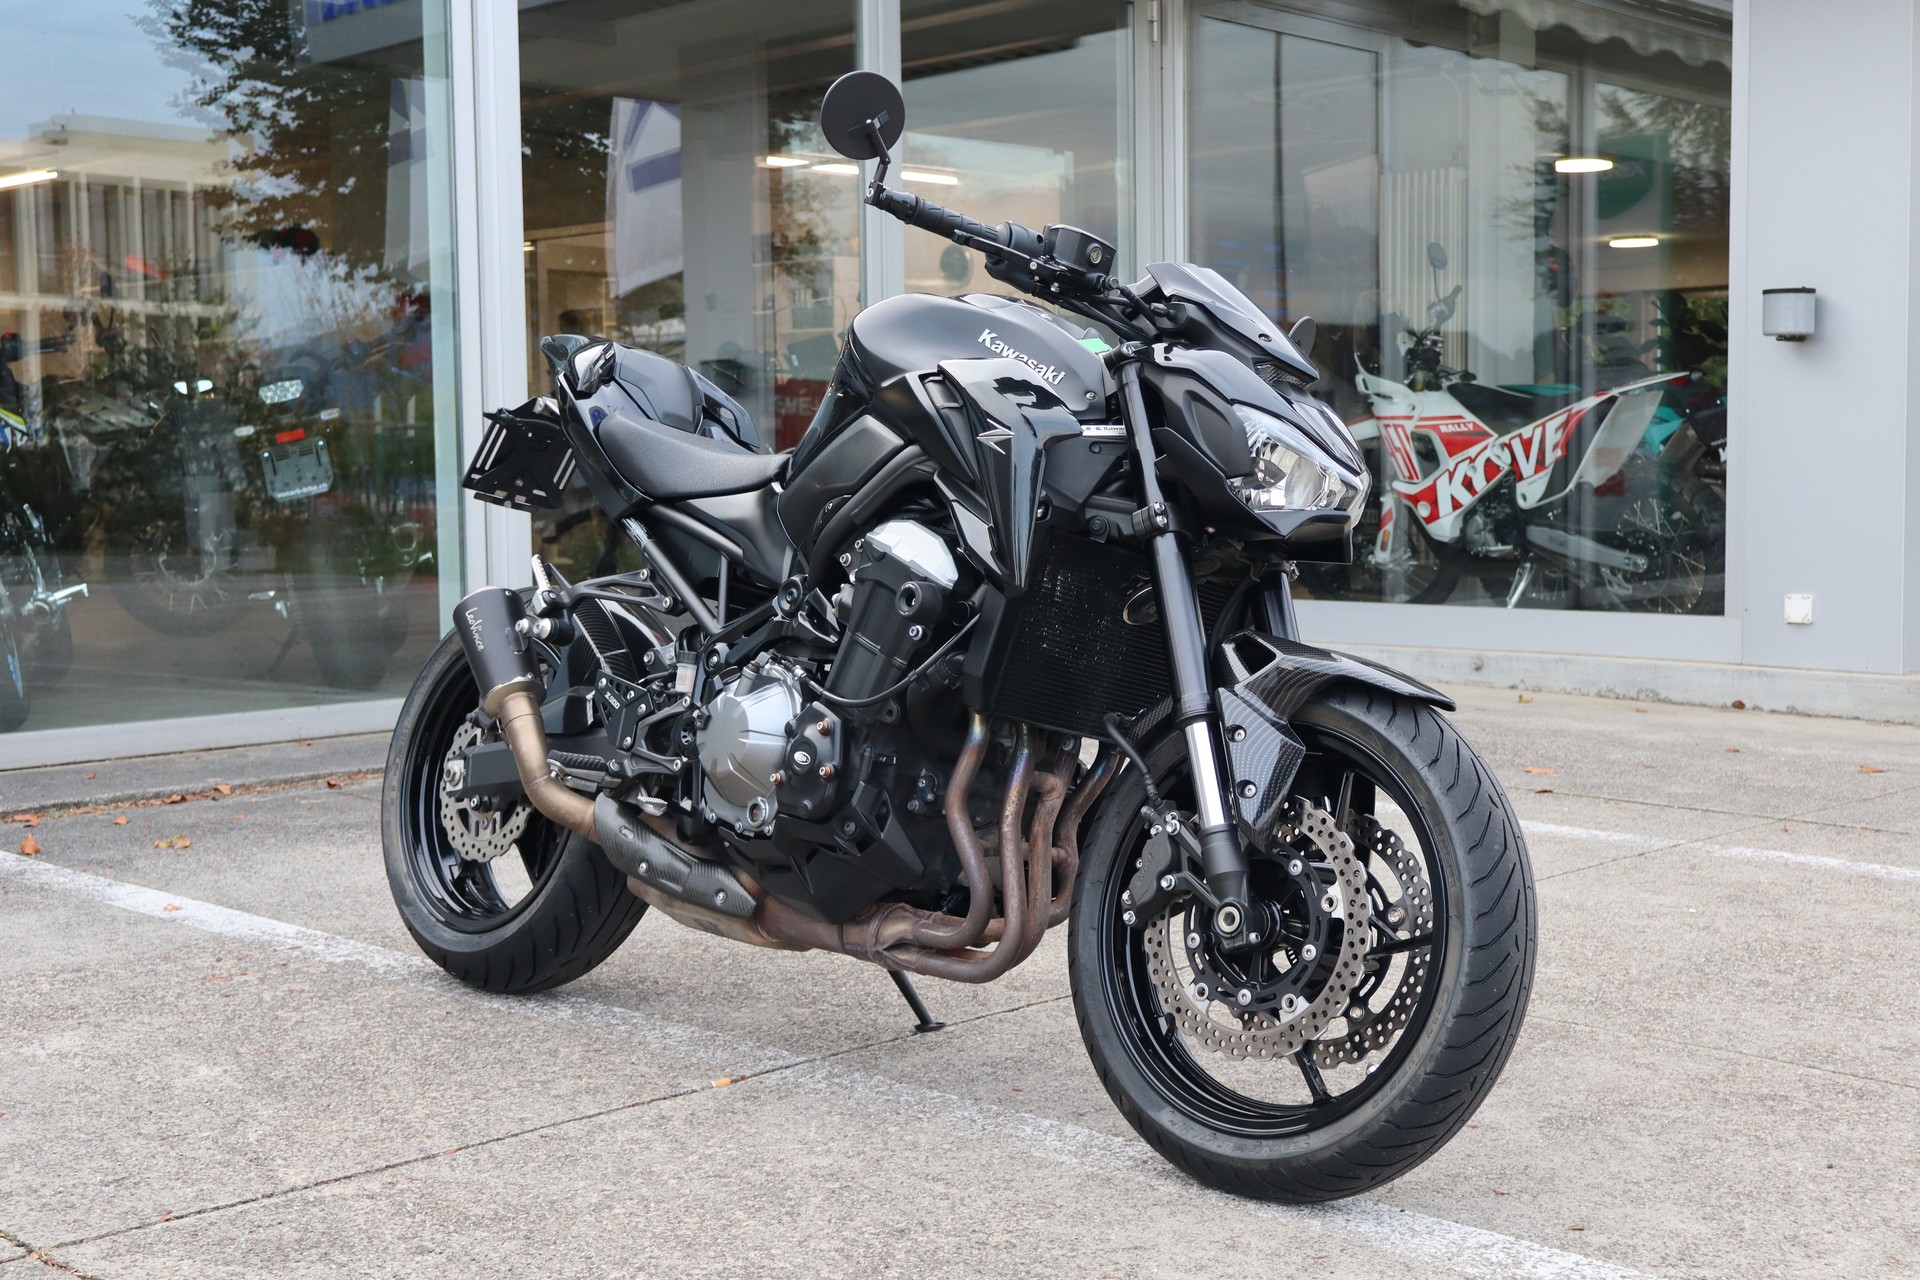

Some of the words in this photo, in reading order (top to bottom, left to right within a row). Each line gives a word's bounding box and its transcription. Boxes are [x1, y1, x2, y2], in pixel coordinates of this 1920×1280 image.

[977, 328, 1066, 386] Kawasaki
[1439, 422, 1474, 433] RALLY
[1435, 410, 1572, 519] KOVE
[465, 607, 485, 652] LeoVince
[604, 691, 621, 710] Z900
